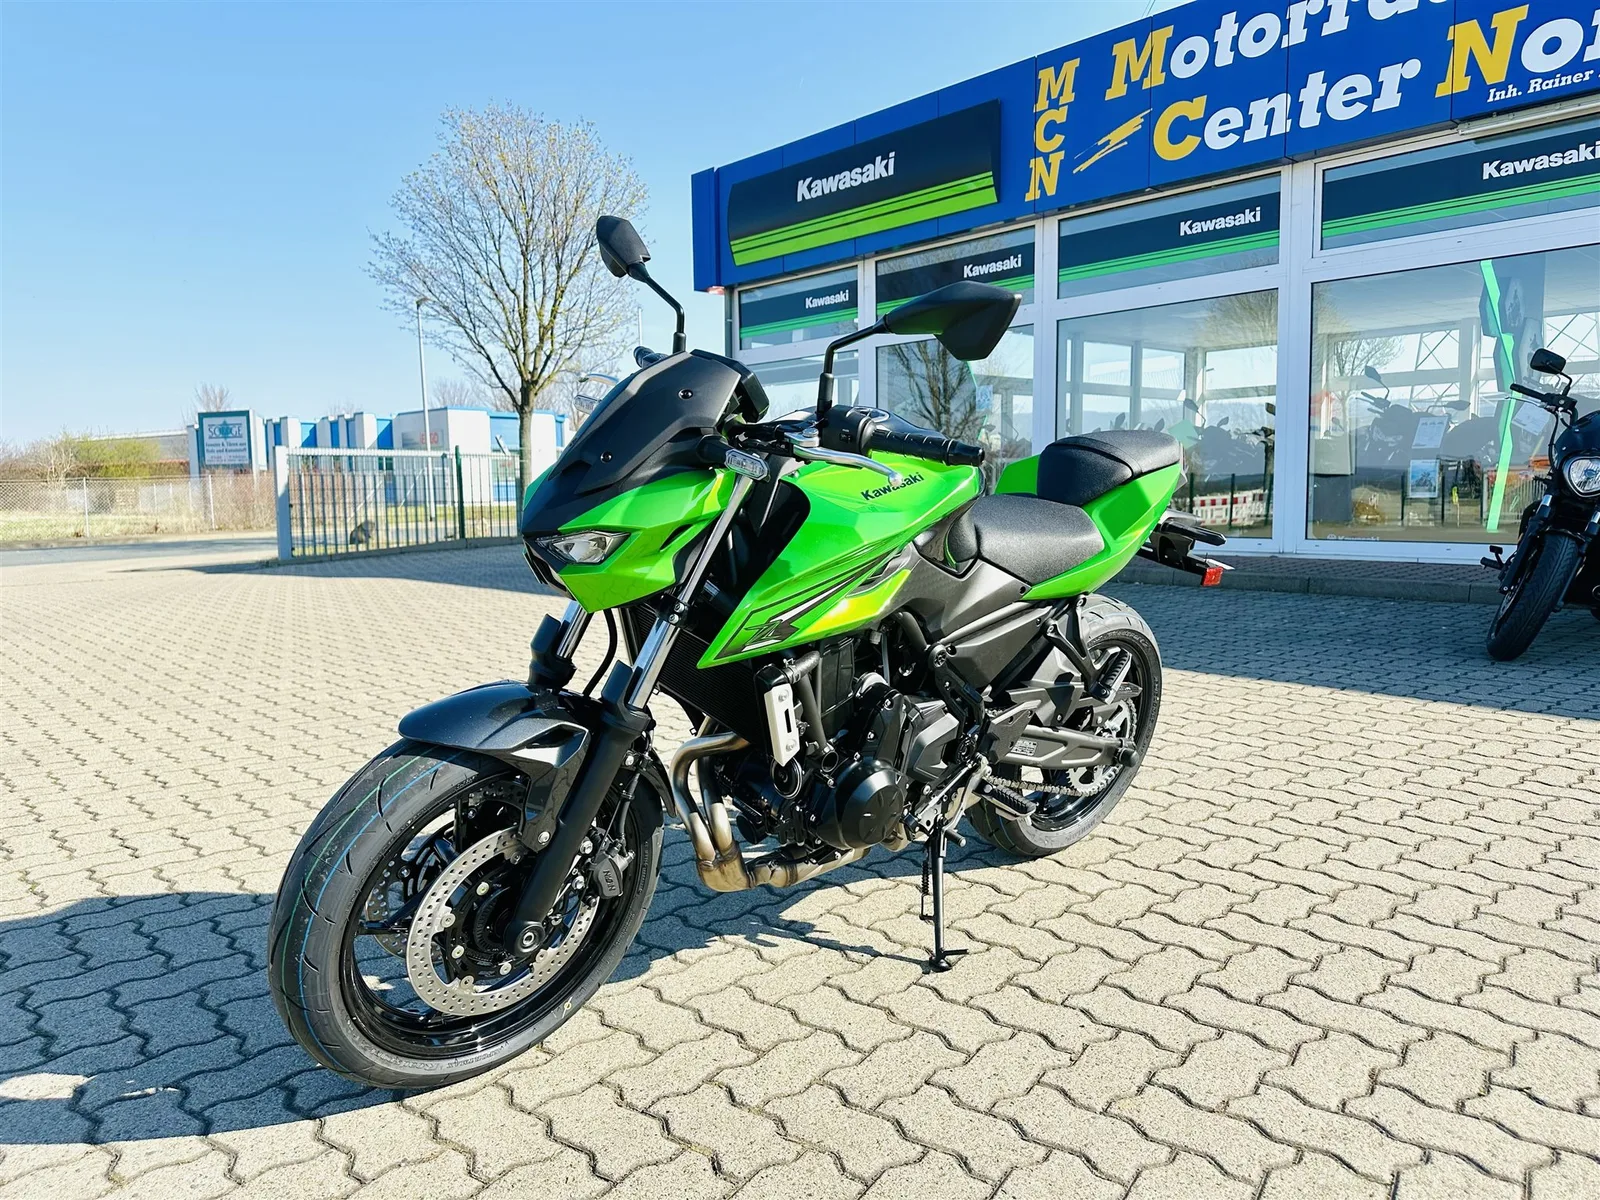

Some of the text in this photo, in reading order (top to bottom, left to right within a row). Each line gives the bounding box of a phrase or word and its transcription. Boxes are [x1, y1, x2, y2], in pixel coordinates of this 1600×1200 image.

[1486, 69, 1595, 103] Inh. Rainer
[1153, 57, 1422, 161] Center
[1482, 139, 1600, 180] Kawasaki
[796, 151, 896, 203] Kawasaki
[1179, 206, 1261, 237] Kawasaki
[963, 254, 1022, 279] Kawasaki
[805, 290, 849, 309] Kawasaki
